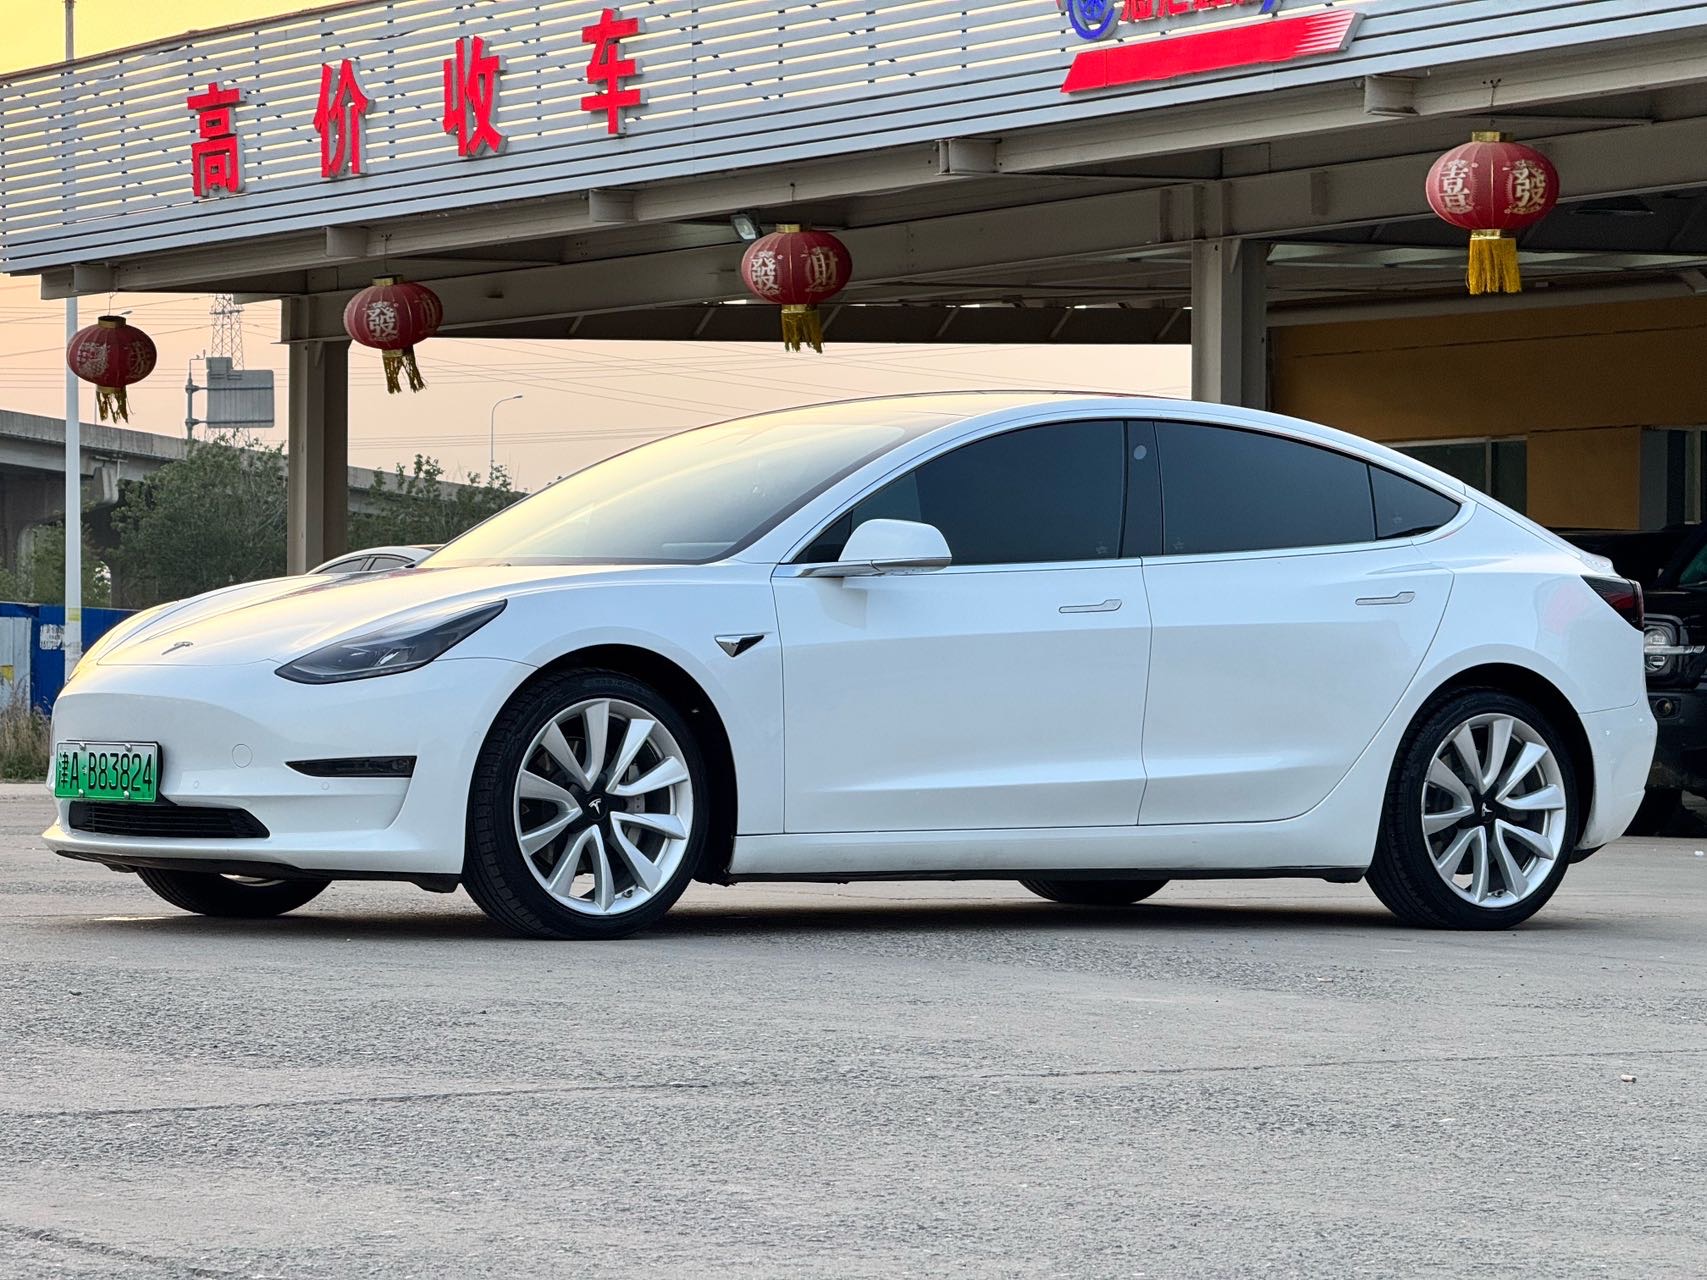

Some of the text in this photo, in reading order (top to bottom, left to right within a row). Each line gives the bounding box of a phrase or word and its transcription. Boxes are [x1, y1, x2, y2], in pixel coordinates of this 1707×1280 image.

[187, 8, 646, 197] 高价收车
[88, 752, 152, 792] B83824
